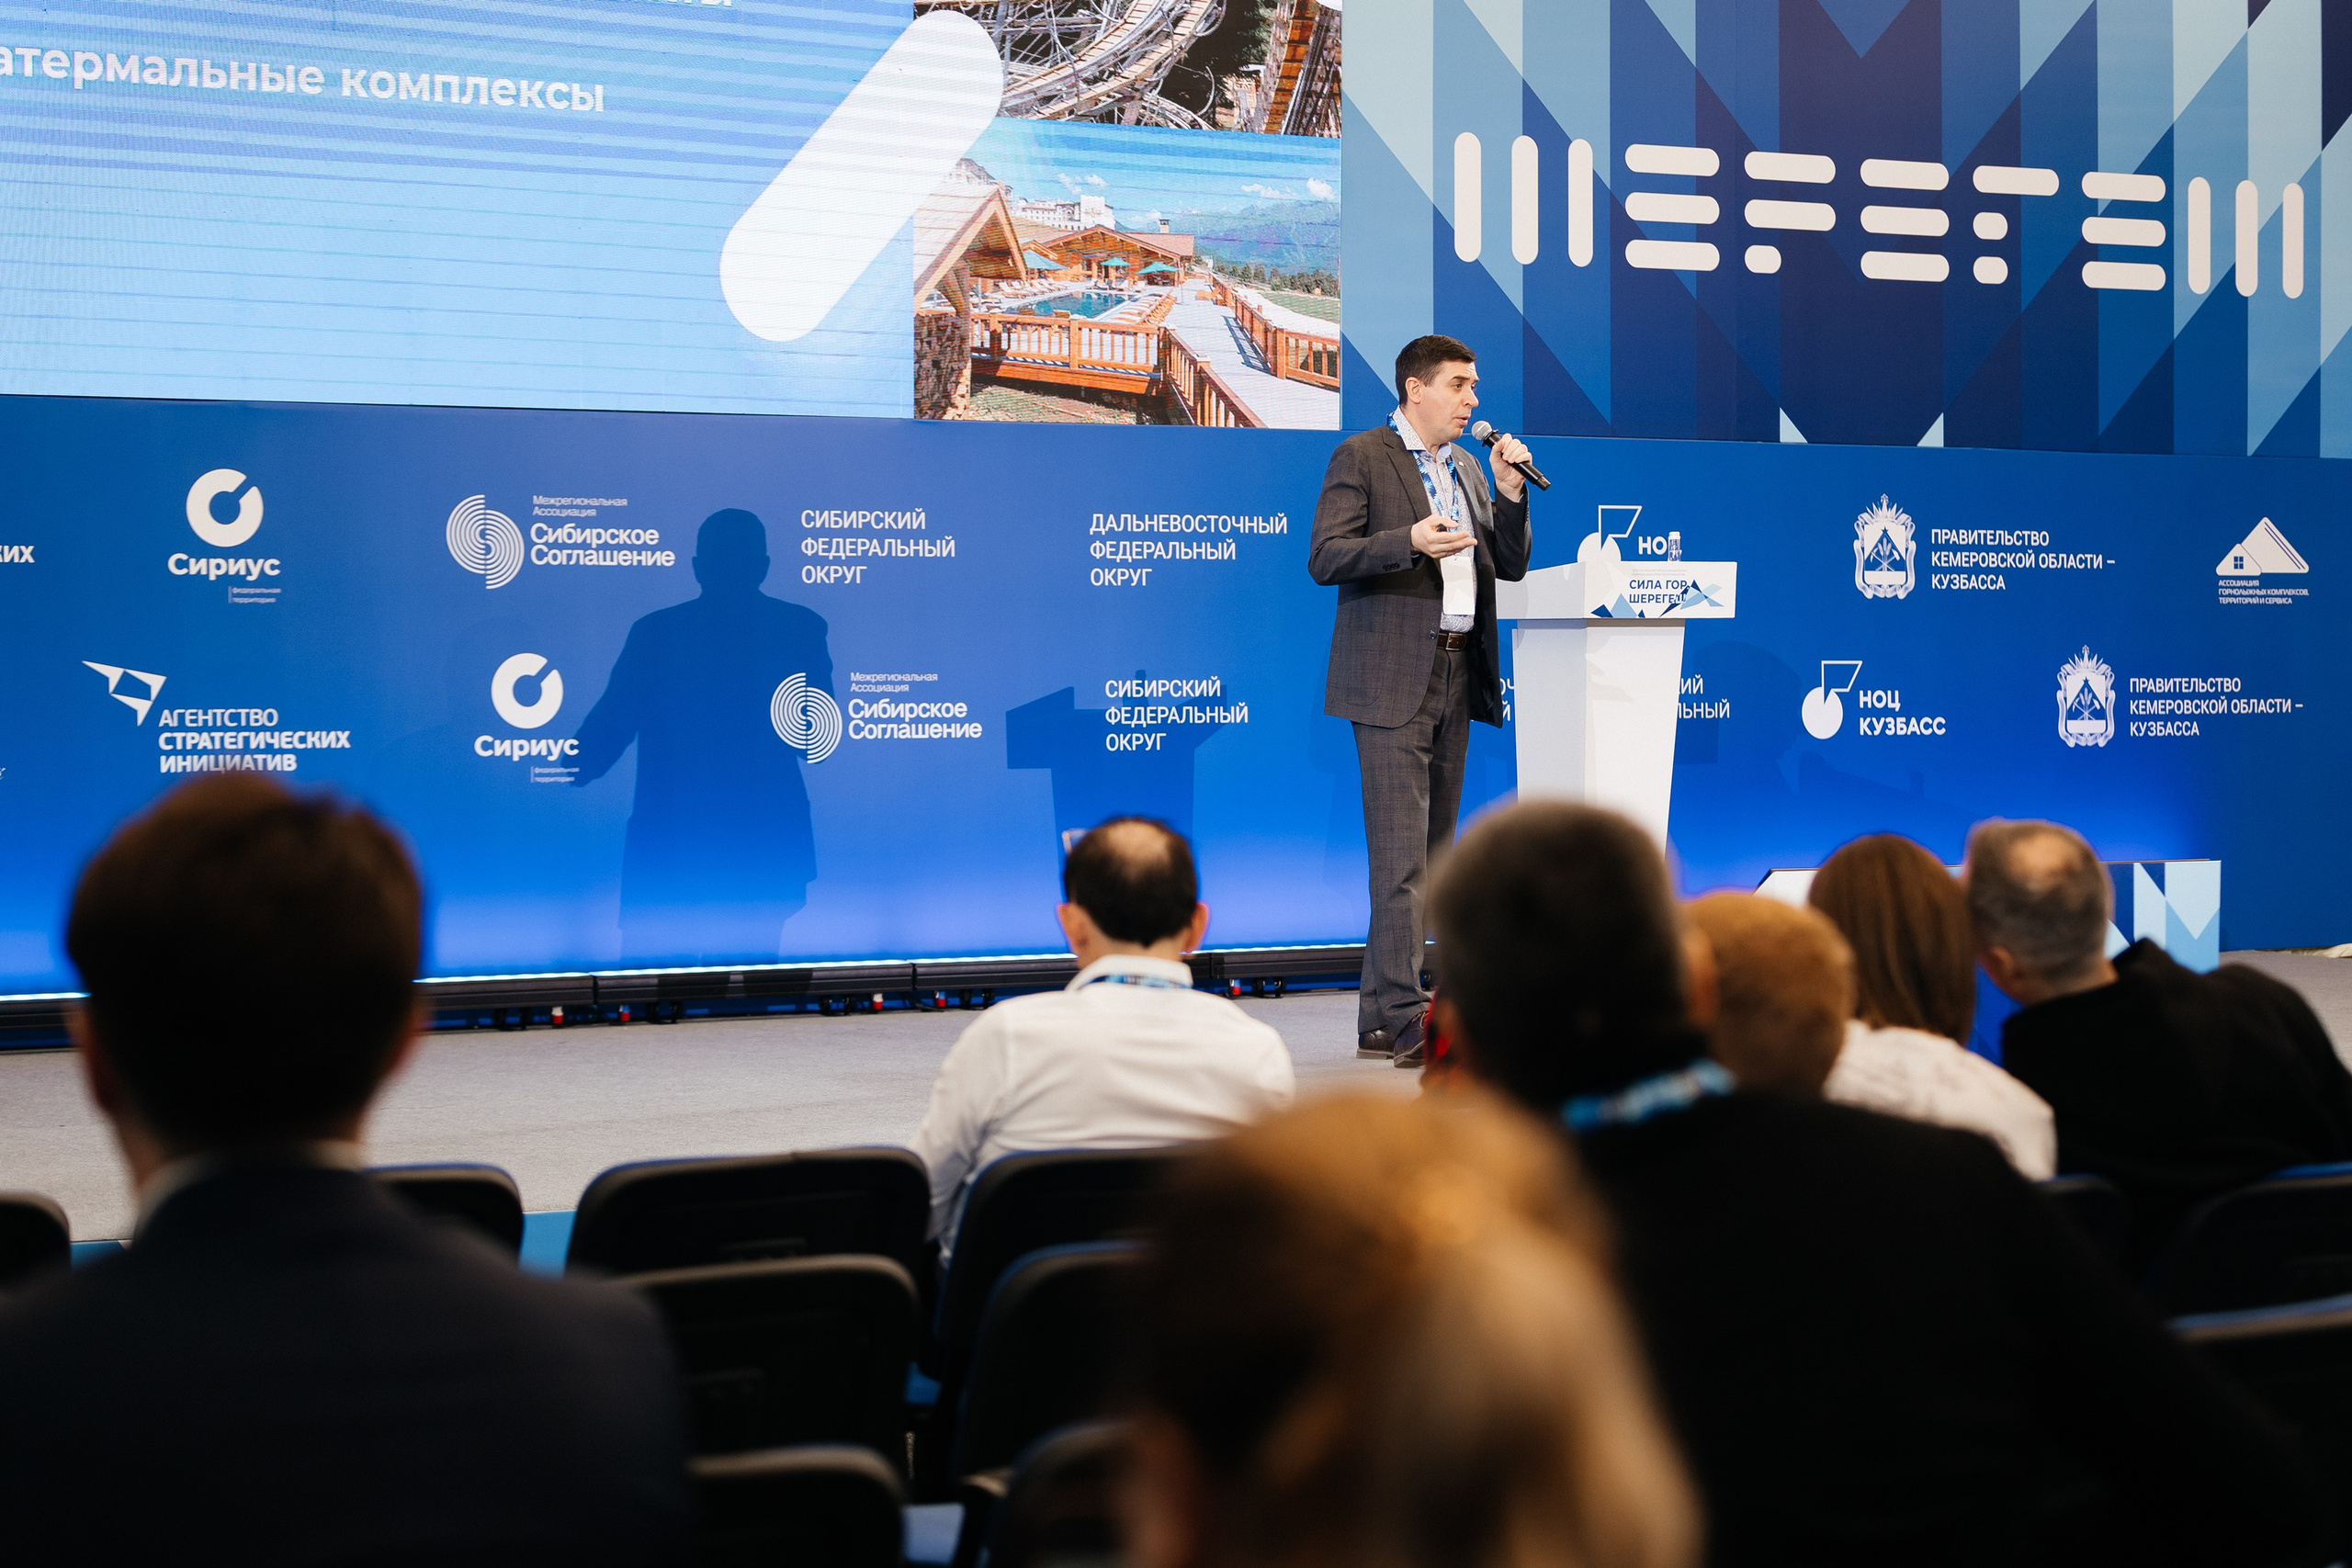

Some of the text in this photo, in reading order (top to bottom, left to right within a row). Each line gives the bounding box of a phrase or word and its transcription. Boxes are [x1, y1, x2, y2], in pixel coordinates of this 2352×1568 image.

[341, 68, 604, 112] комплексы
[1454, 131, 2303, 299] ШЕРЕГЕШ
[532, 495, 628, 508] Межрегиональная
[532, 507, 597, 517] Ассоциация
[801, 508, 926, 530] СИБИРСКИЙ
[1089, 513, 1287, 536] ДАЛЬНЕВОСТОЧНЫЙ
[530, 522, 660, 548] Сибирское
[1931, 528, 2050, 547] ПРАВИТЕЛЬСТВО
[0, 545, 35, 563] ИХ
[530, 545, 676, 567] Соглашение
[801, 536, 956, 560] ФЕДЕРАЛЬНЫЙ
[1090, 538, 1236, 563] ФЕДЕРАЛЬНЫЙ
[1638, 536, 1678, 558] НО
[167, 552, 281, 581] Сириус
[1931, 549, 2035, 569] КЕМЕРОВСКОЙ
[2038, 553, 2103, 570] ОБЛАСТИ
[801, 565, 867, 584] ОКРУГ
[1090, 568, 1153, 586] ОКРУГ
[1629, 579, 1688, 590] СИЛА ГОР
[1931, 573, 2006, 591] КУЗБАССА
[850, 671, 938, 682] Межрегиональная
[1680, 673, 1703, 694] ИЙ
[2130, 678, 2242, 693] ПРАВИТЕЛЬСТВО
[850, 682, 910, 693] Ассоциация
[1104, 676, 1221, 698] СИБИРСКИЙ
[848, 698, 968, 720] Сибирское
[1859, 690, 1901, 712] НОЦ
[2130, 696, 2228, 715] КЕМЕРОВСКОЙ
[2231, 698, 2291, 714] ОБЛАСТИ
[158, 708, 279, 728] АГЕНТСТВО
[1104, 702, 1249, 728] ФЕДЕРАЛЬНЫЙ
[848, 719, 983, 739] Соглашение
[1860, 716, 1946, 736] КУЗБАСС
[2130, 720, 2199, 736] КУЗБАССА
[158, 730, 351, 750] СТРАТЕГИЧЕСКИХ
[473, 735, 580, 761] Сириус
[1105, 732, 1167, 751] ОКРУГ
[160, 753, 298, 773] ИНИЦИАТИВ
